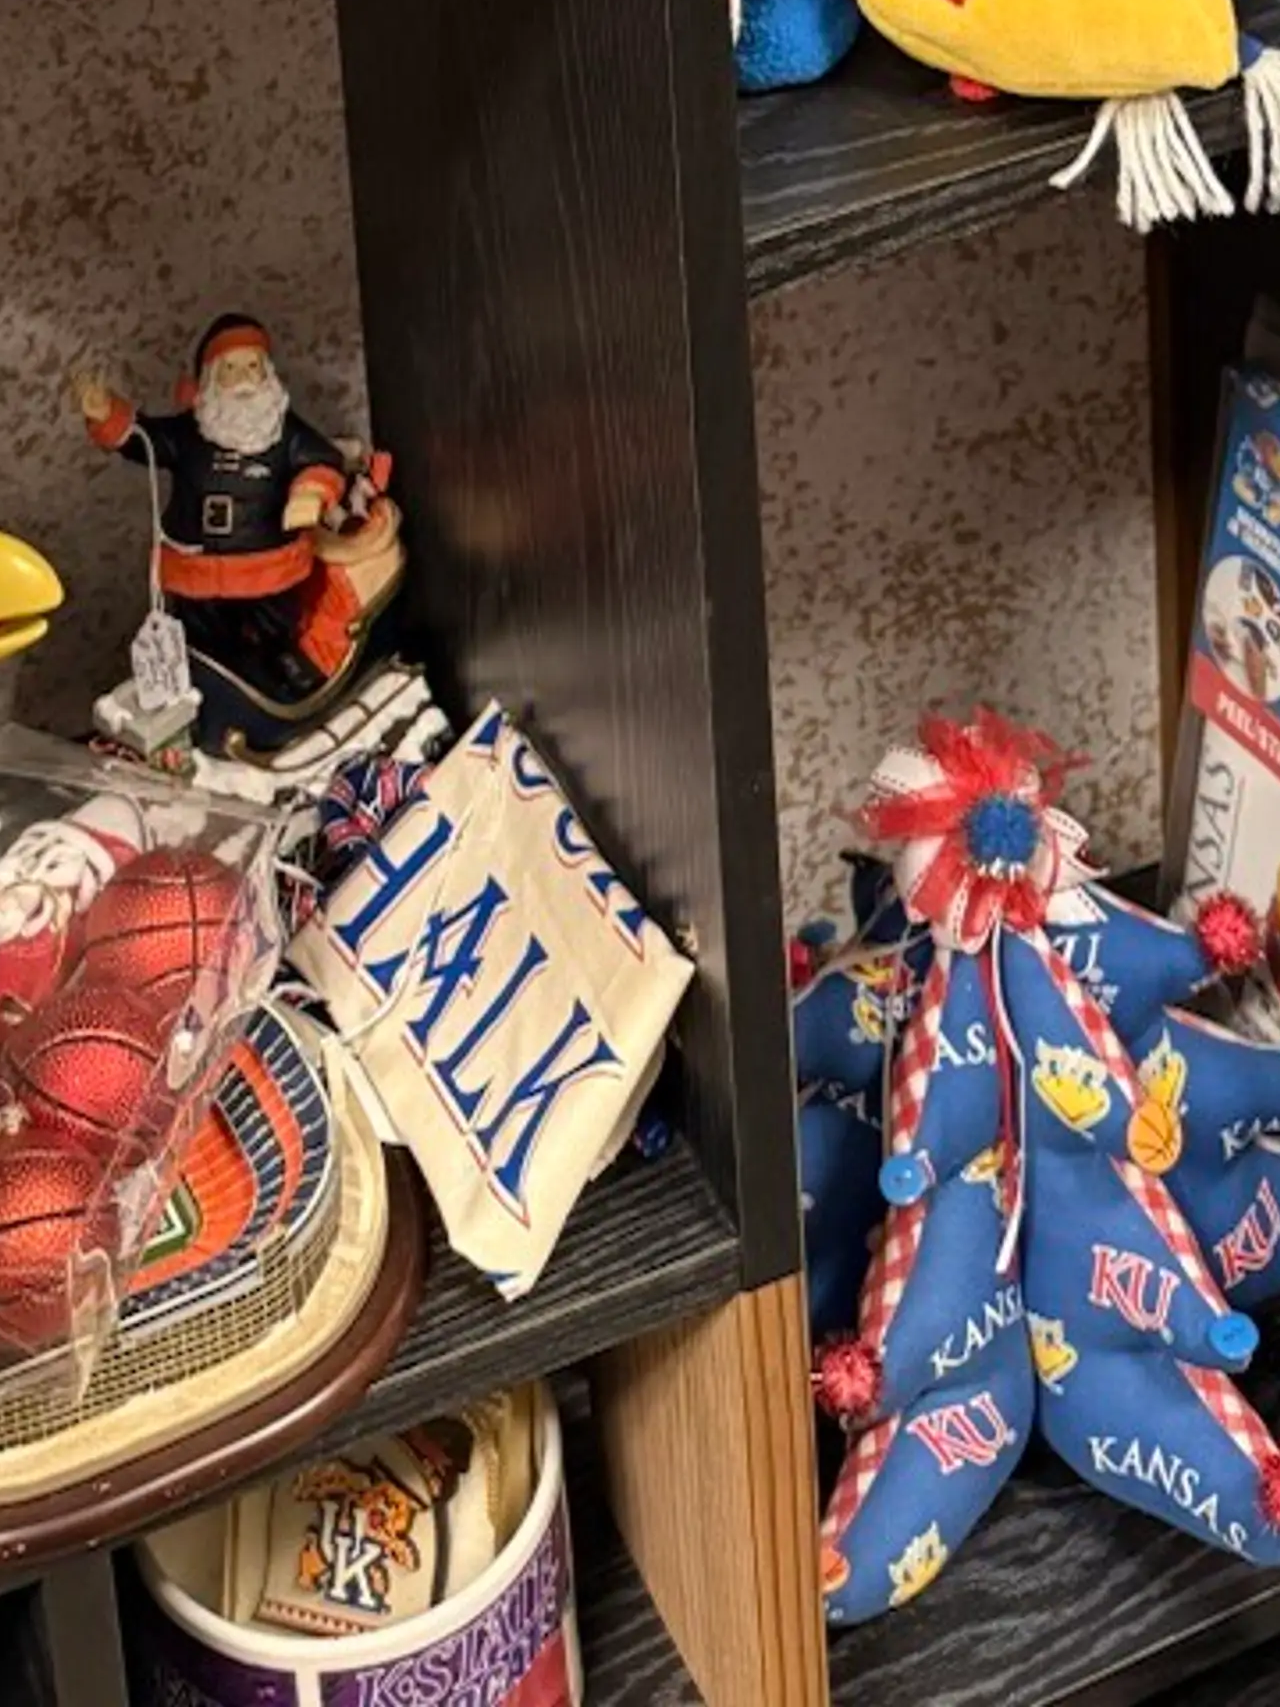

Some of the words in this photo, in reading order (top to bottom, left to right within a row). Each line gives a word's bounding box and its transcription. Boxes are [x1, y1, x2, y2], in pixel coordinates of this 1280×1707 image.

[1090, 1244, 1181, 1333] KU
[906, 1392, 1012, 1475] KU
[1087, 1436, 1250, 1553] KANSAS
